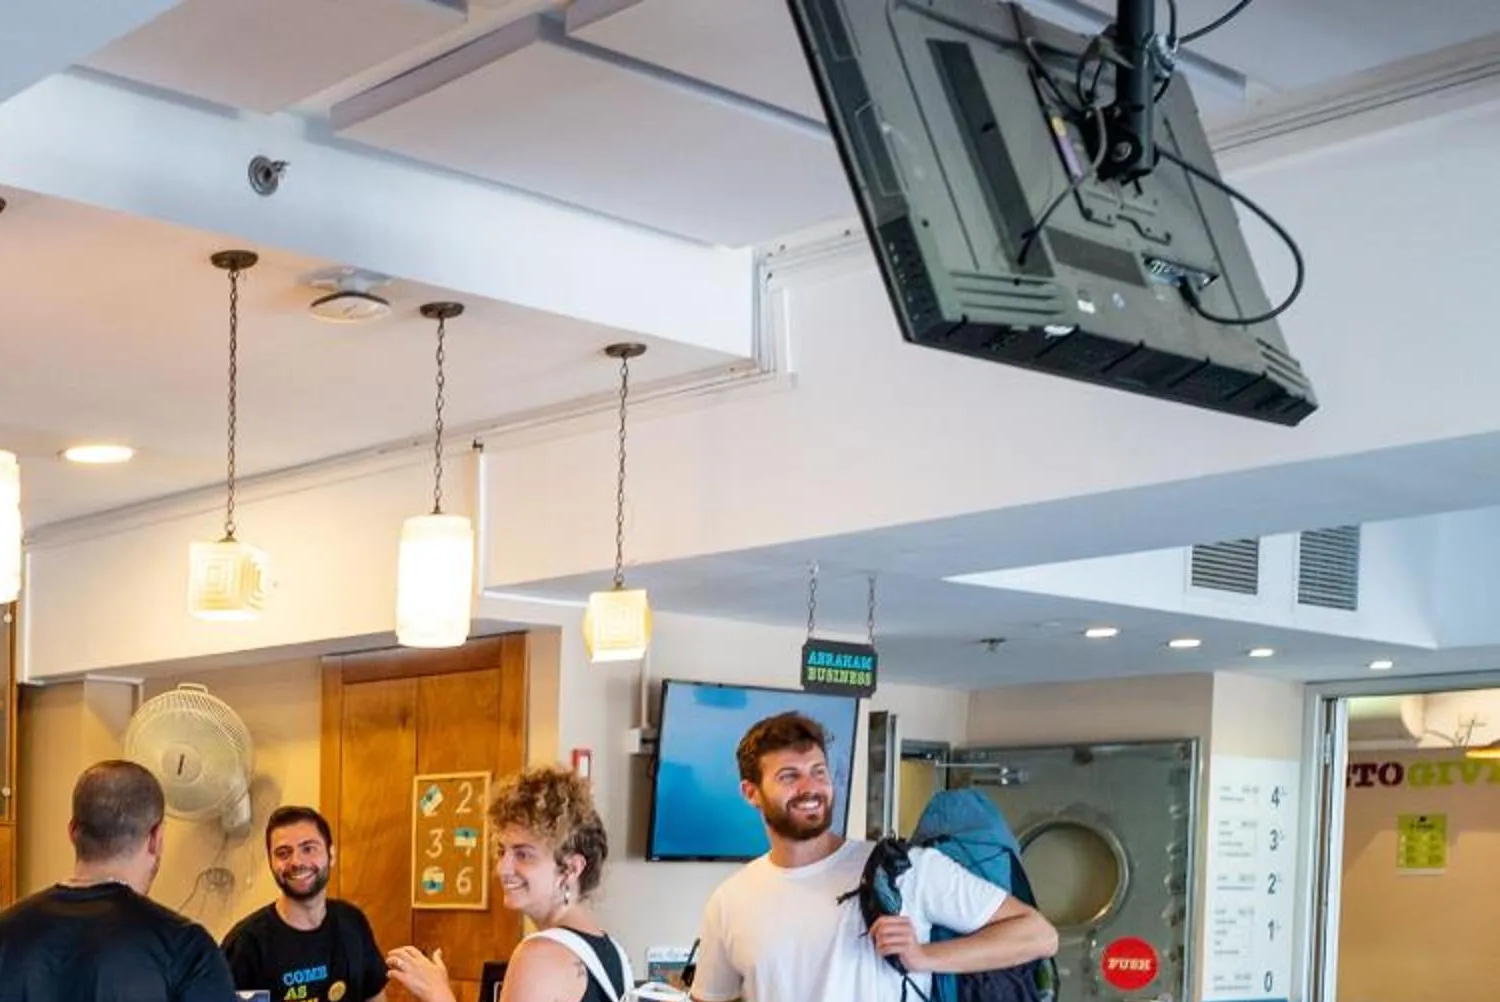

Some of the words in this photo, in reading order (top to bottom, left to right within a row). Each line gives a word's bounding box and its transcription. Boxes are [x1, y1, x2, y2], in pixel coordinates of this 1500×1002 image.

[807, 650, 873, 670] ABRAHAM
[807, 666, 872, 687] BUSINESS
[455, 781, 474, 814] 2
[424, 828, 445, 859] 3
[1269, 828, 1279, 852] 3
[456, 866, 474, 895] 6
[1267, 872, 1277, 895] 2
[1267, 919, 1275, 941] 1
[1107, 957, 1152, 971] PUSH
[282, 965, 328, 986] COME
[1263, 970, 1273, 993] 0
[284, 985, 307, 1000] AS
